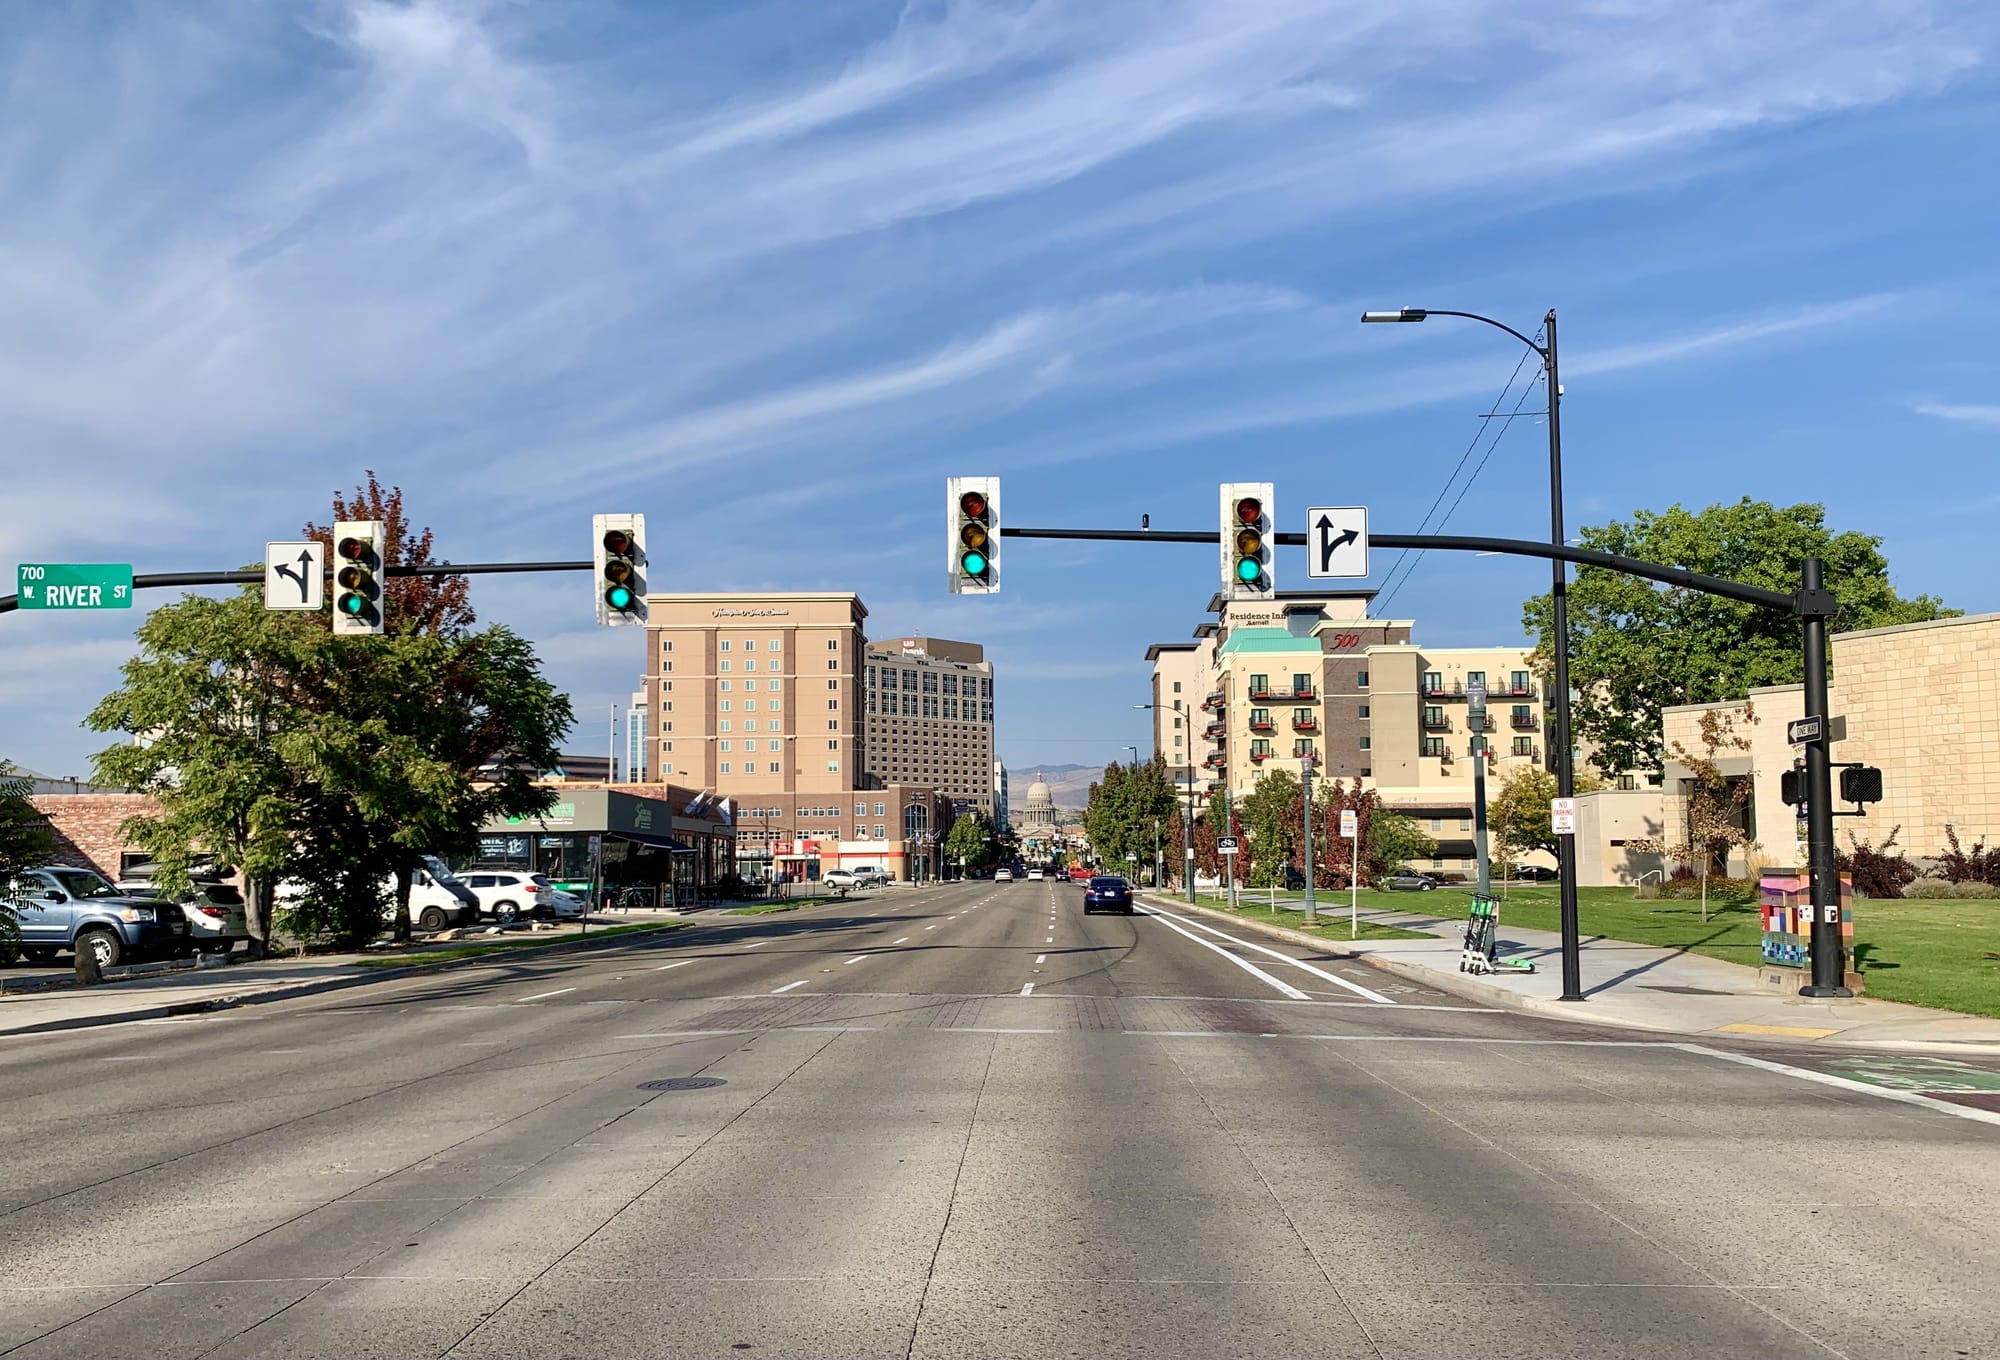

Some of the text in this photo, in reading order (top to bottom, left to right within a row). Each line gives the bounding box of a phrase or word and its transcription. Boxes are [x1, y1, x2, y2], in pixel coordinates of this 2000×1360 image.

[21, 566, 44, 580] 700
[23, 585, 128, 606] W. RIVER ST
[1230, 612, 1287, 620] Residence Inn
[1329, 633, 1360, 650] 500
[902, 647, 926, 656] bank
[1797, 724, 1817, 736] ONE WAY
[1558, 801, 1568, 809] NO
